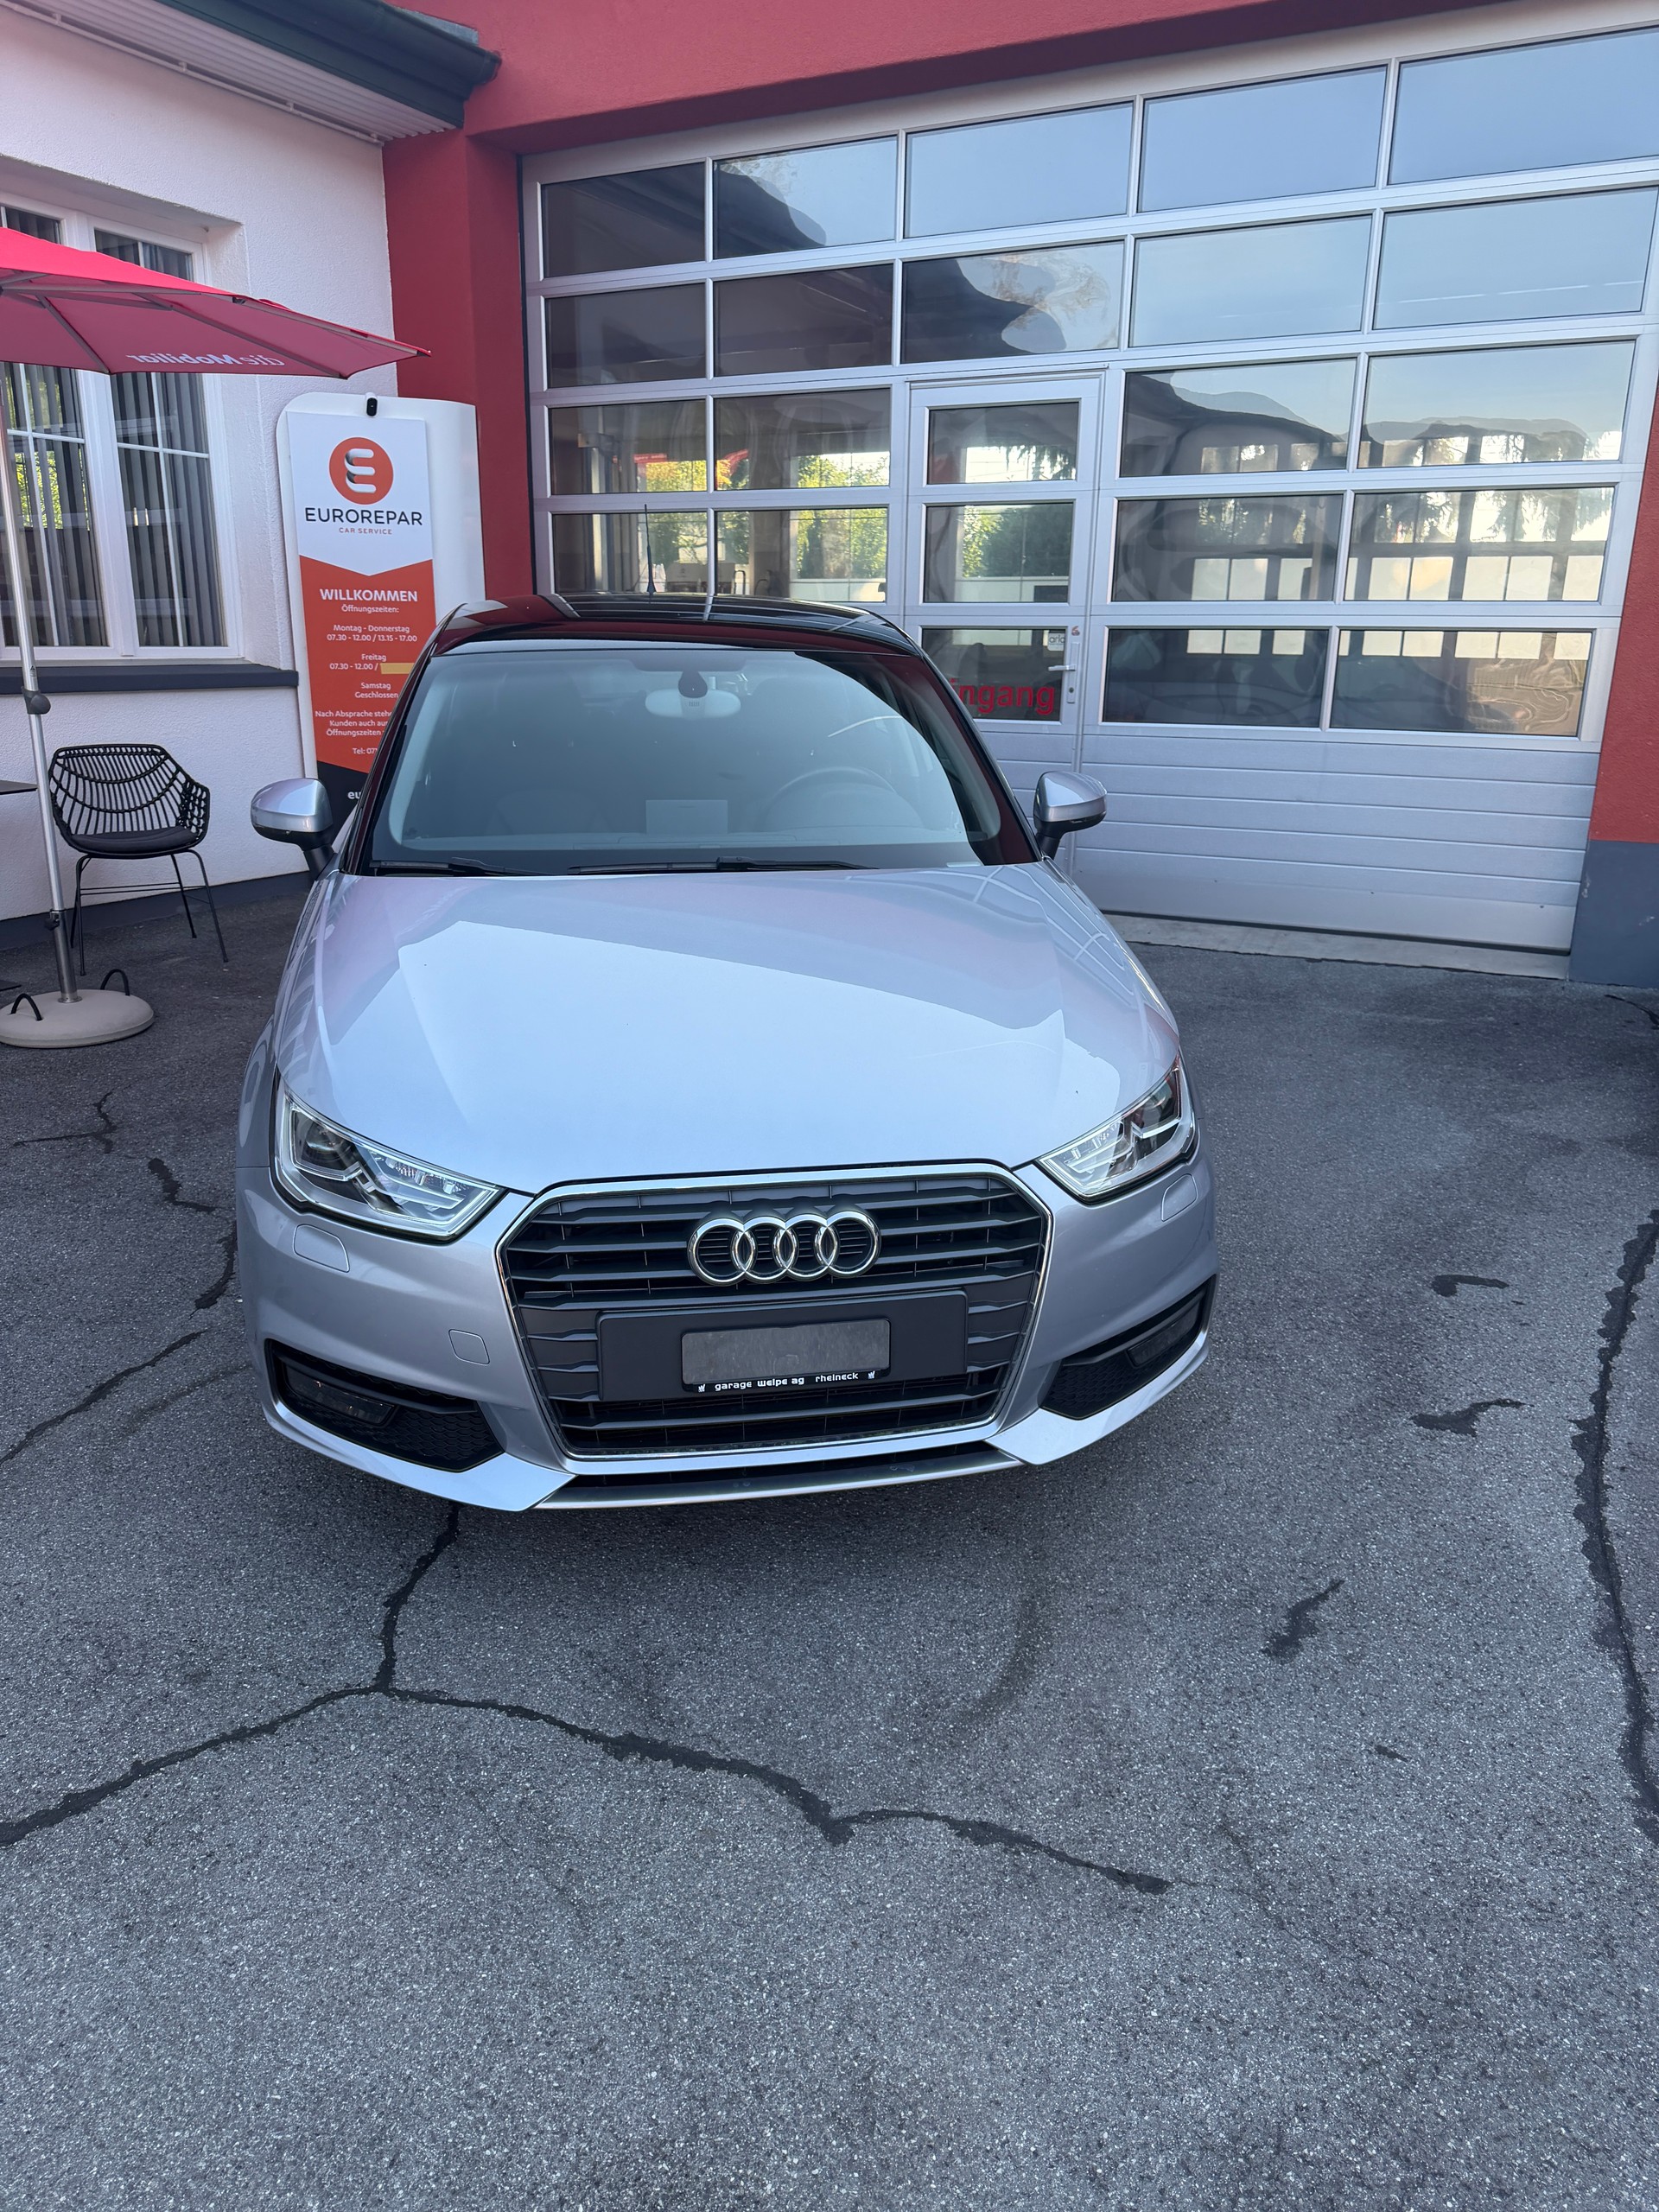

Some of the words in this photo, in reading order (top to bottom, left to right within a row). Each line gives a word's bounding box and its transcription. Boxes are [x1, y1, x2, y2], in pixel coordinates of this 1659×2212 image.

[304, 507, 423, 526] EUROREPAR
[320, 588, 418, 602] WILLKOMMEN
[341, 604, 399, 613] Öffnungszeiten:
[361, 653, 386, 662] Freitag
[361, 682, 391, 690] Samstag
[335, 710, 372, 719] Absprache
[326, 728, 381, 737] Öffnungszeiten
[347, 791, 361, 800] eu
[715, 1381, 753, 1391] garage
[791, 1377, 805, 1386] ag
[815, 1372, 859, 1383] rheineck
